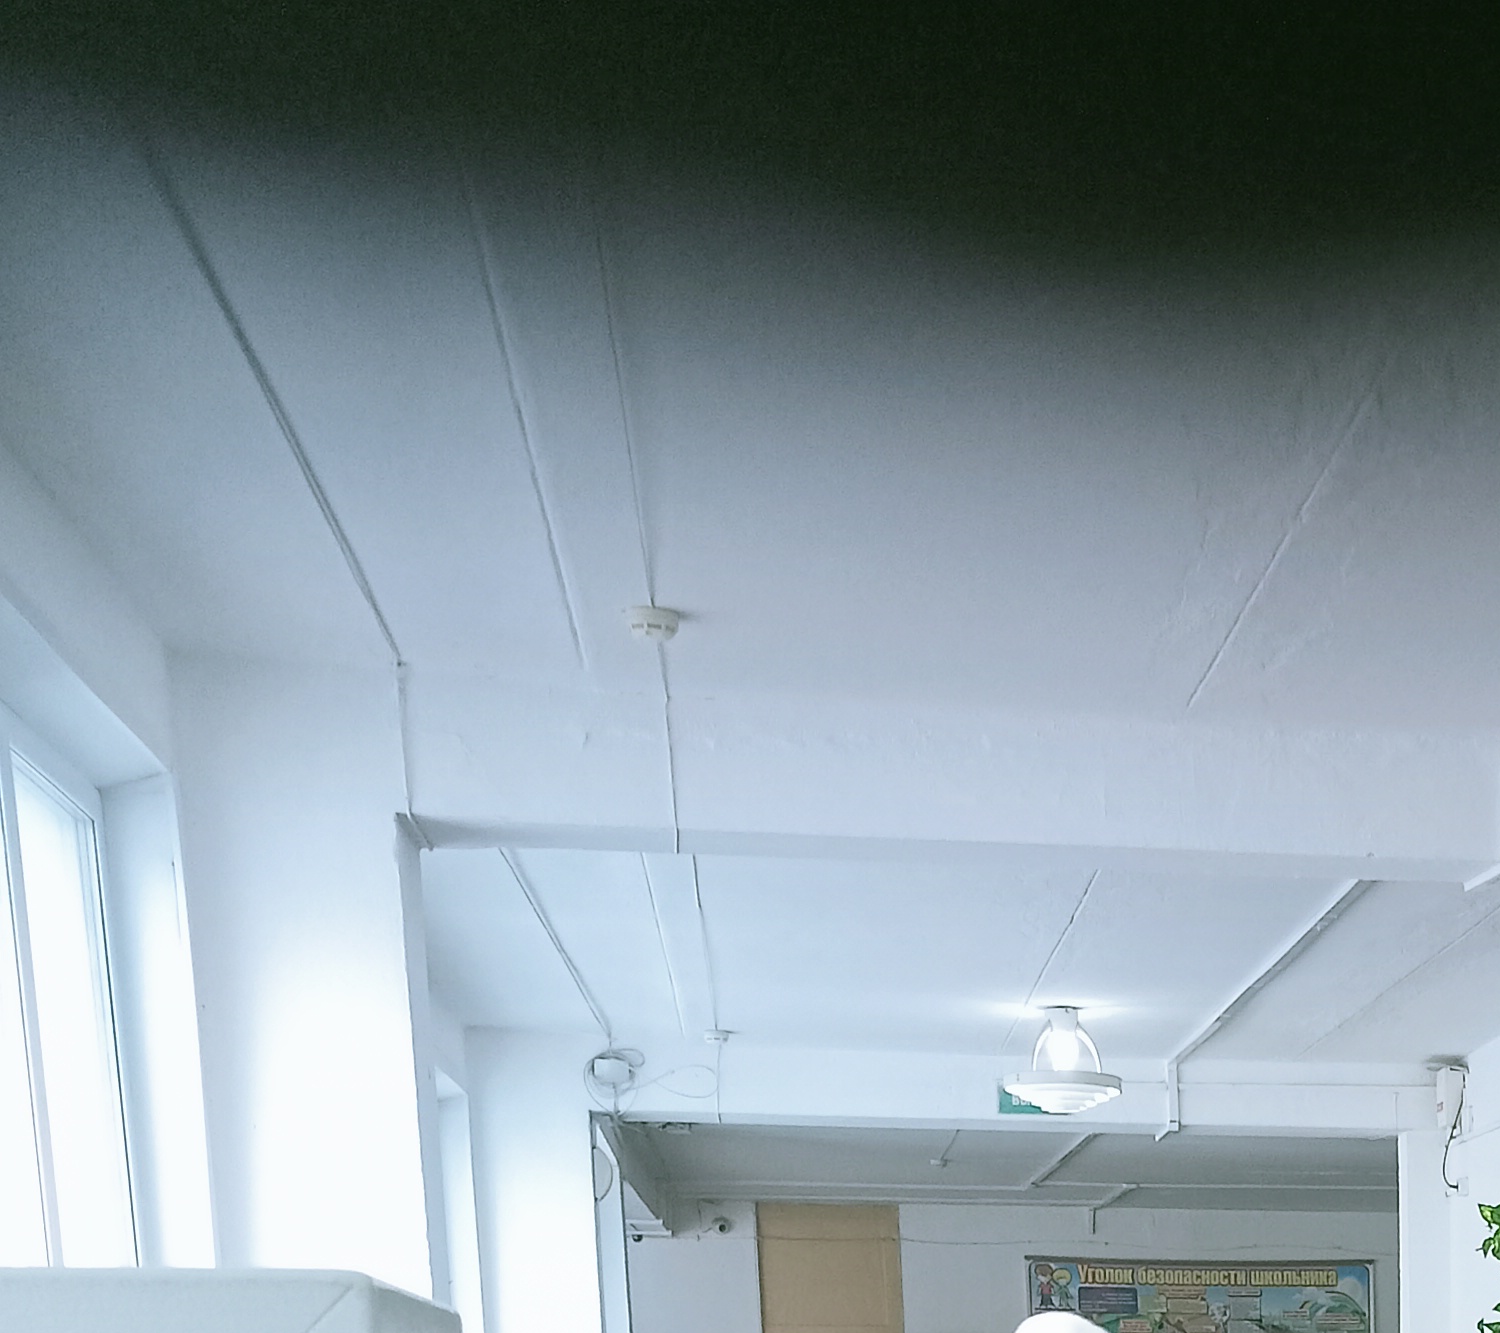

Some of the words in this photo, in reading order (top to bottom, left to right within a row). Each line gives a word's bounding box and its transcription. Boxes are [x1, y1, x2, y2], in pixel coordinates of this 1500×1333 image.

[1077, 1264, 1135, 1285] Уголок
[1137, 1266, 1247, 1287] безопасности
[1249, 1268, 1338, 1287] школьника
